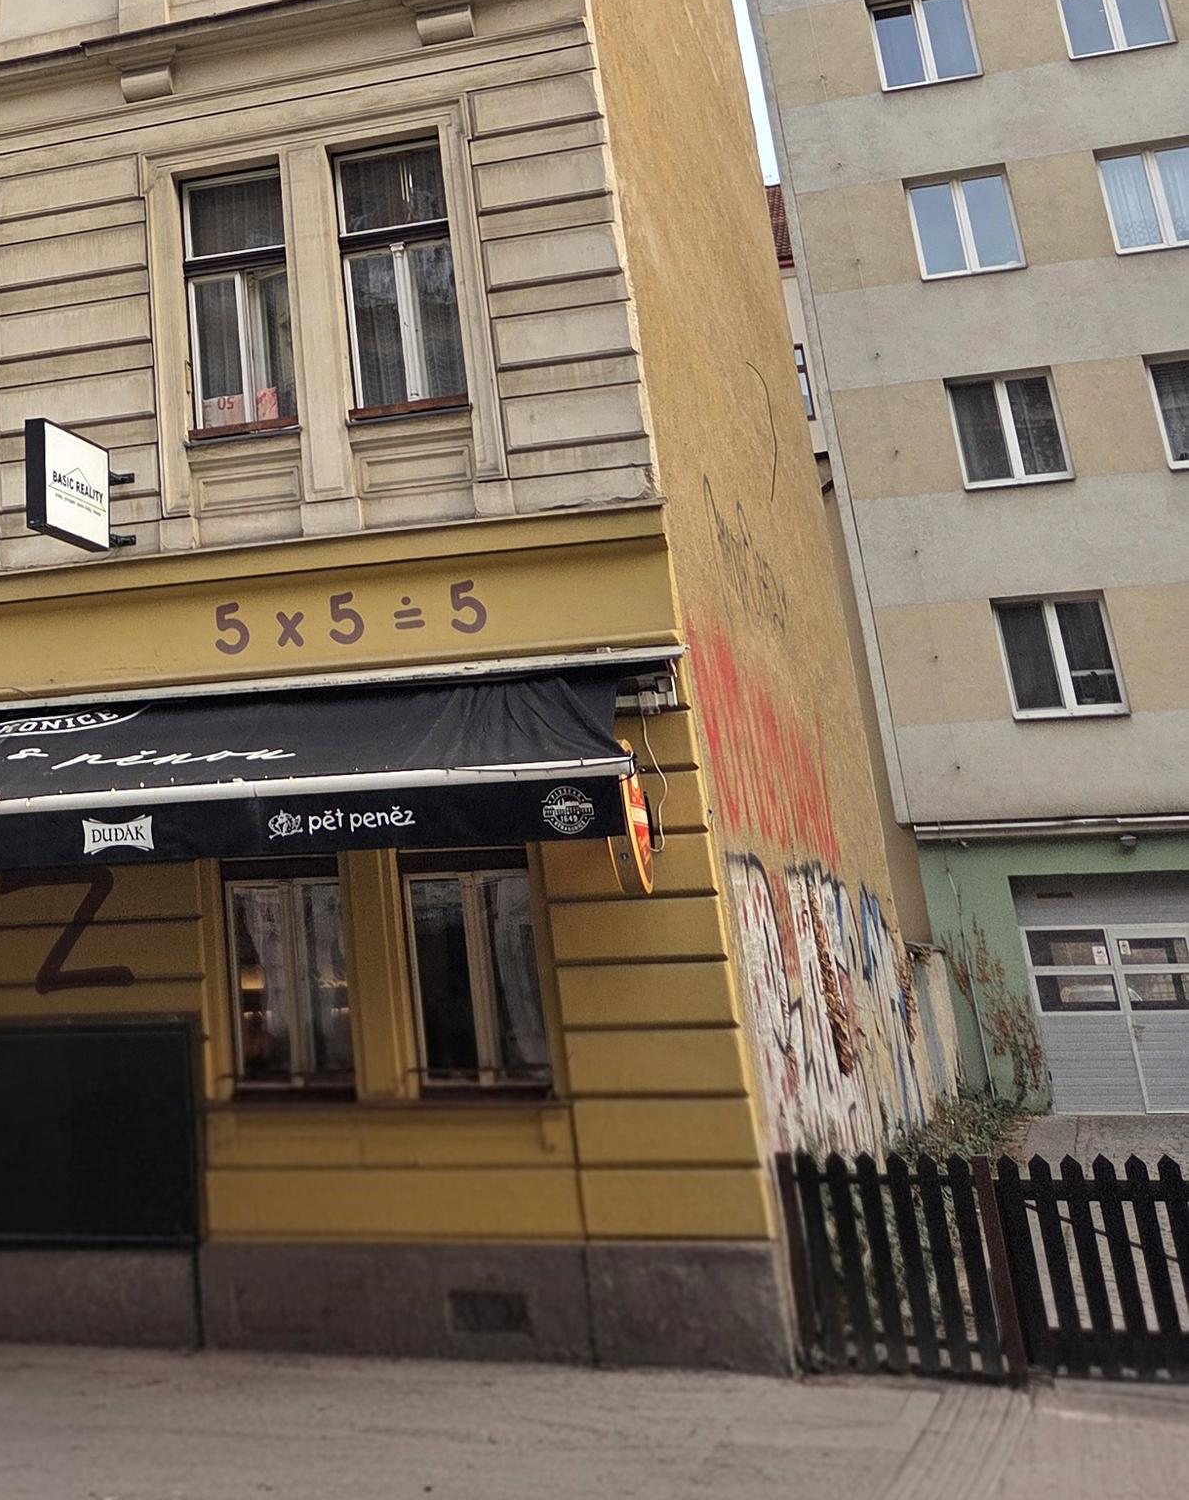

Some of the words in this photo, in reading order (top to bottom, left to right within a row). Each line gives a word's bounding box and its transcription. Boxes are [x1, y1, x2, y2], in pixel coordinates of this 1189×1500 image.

[52, 470, 74, 490] BASIC
[75, 481, 103, 504] REALITY
[215, 601, 250, 655] 5
[329, 591, 364, 644] 5
[450, 579, 487, 634] 5
[91, 825, 147, 844] DUDÁK
[308, 809, 344, 834] pět
[349, 806, 416, 832] peněz
